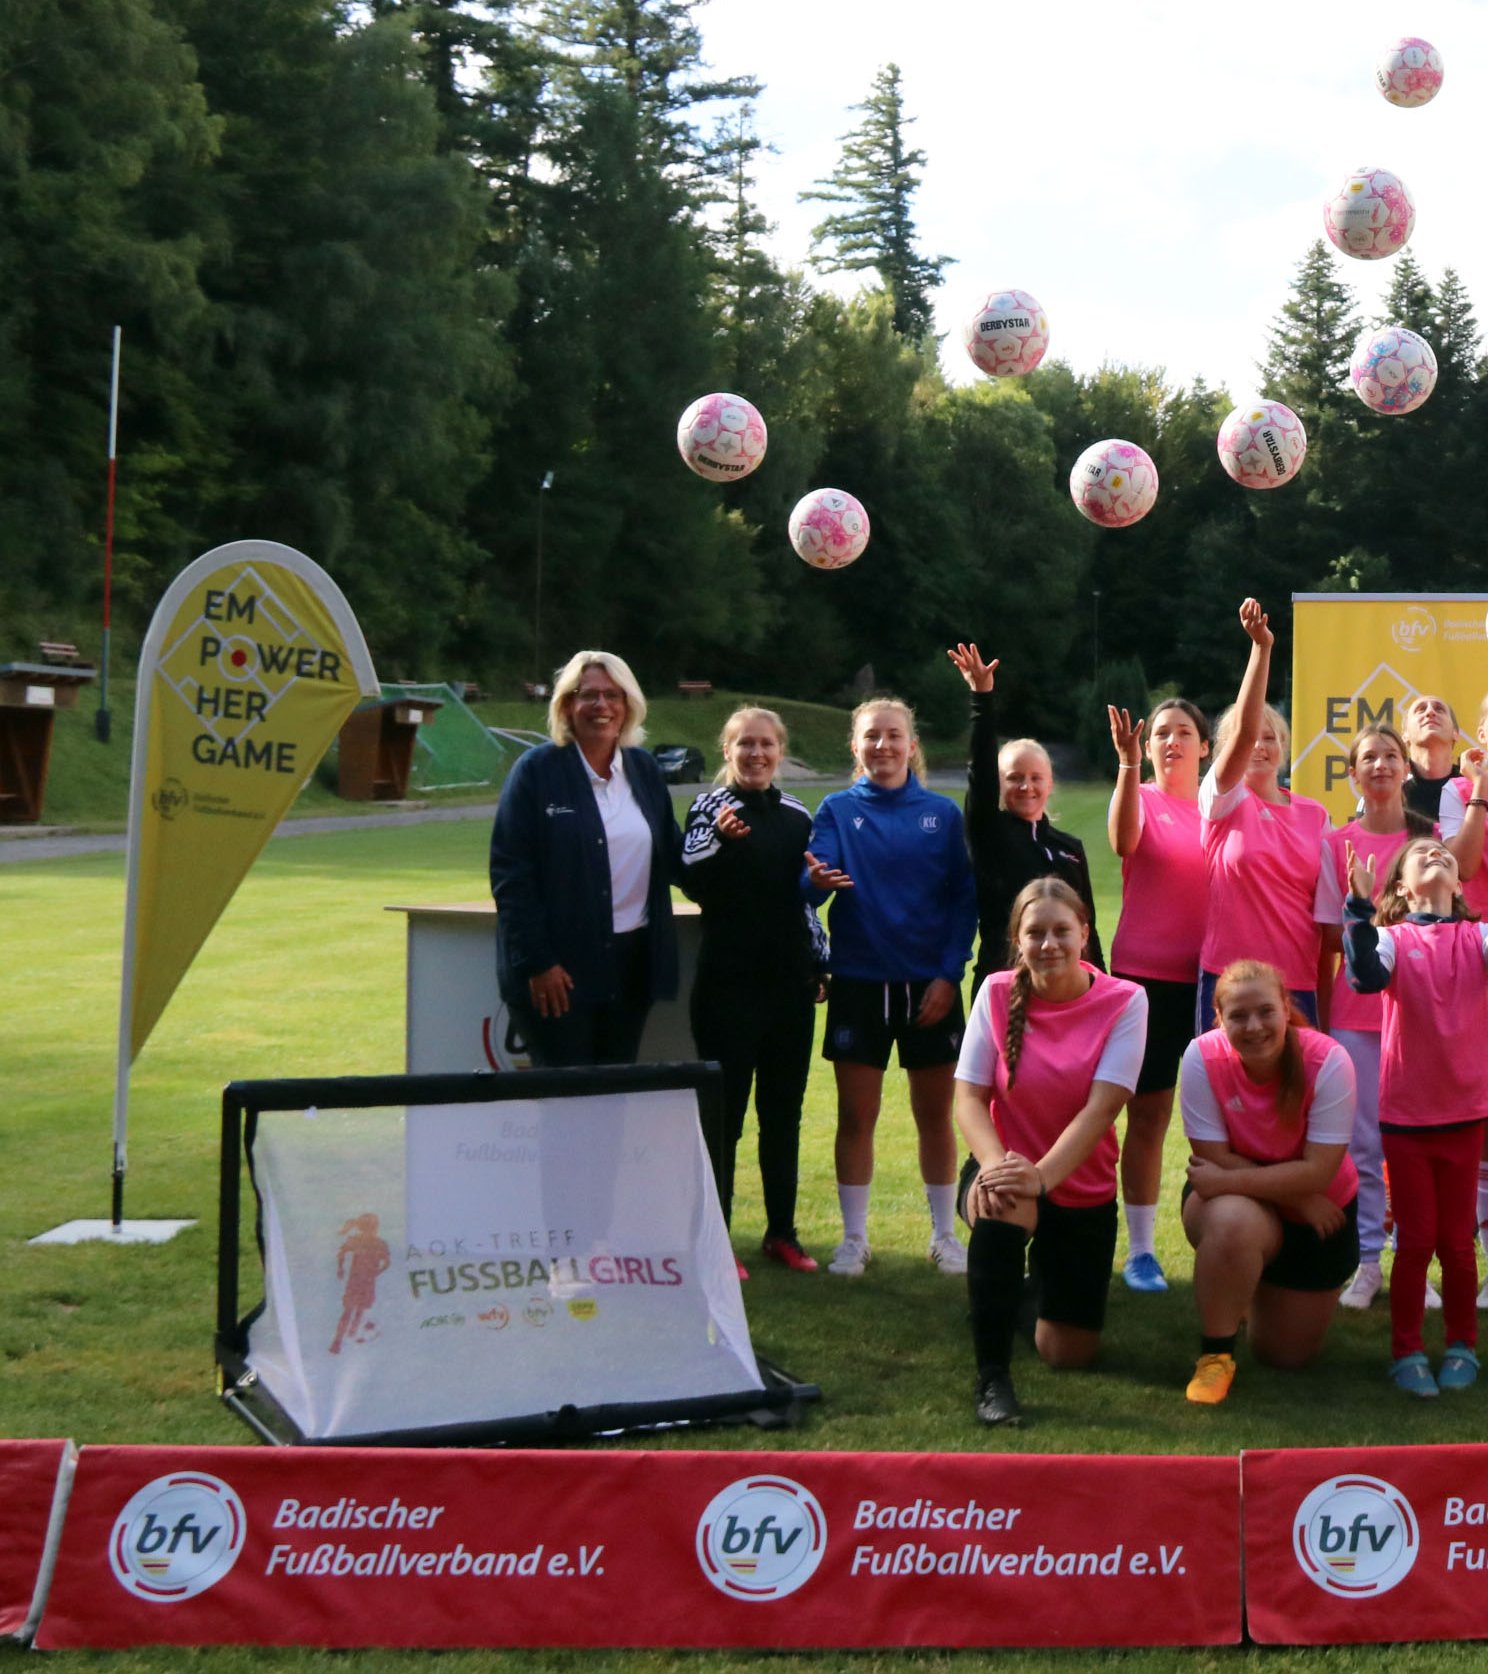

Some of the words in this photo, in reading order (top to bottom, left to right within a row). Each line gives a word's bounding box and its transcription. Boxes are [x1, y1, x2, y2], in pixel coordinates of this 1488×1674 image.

[980, 318, 1030, 332] DERBYSTAR
[696, 454, 745, 472] DERBYSTAR
[1262, 430, 1286, 476] DERBYSTAR
[203, 590, 257, 625] EM
[196, 685, 268, 722] HER
[1326, 697, 1394, 734] EM
[191, 734, 297, 773] GAME
[923, 816, 937, 828] KSC
[405, 1229, 576, 1261] AOK-TREFF
[408, 1256, 684, 1299] FUSSBALLGIRLS
[273, 1497, 445, 1529] Badischer
[853, 1498, 1021, 1530] Badischer
[136, 1513, 221, 1554] bfv
[721, 1515, 802, 1555] bfv
[1318, 1513, 1396, 1553] bfv
[266, 1543, 544, 1576] Fußballverband
[547, 1545, 604, 1576] e.V.
[851, 1543, 1123, 1576] Fußballverband
[1129, 1545, 1186, 1576] e.V.
